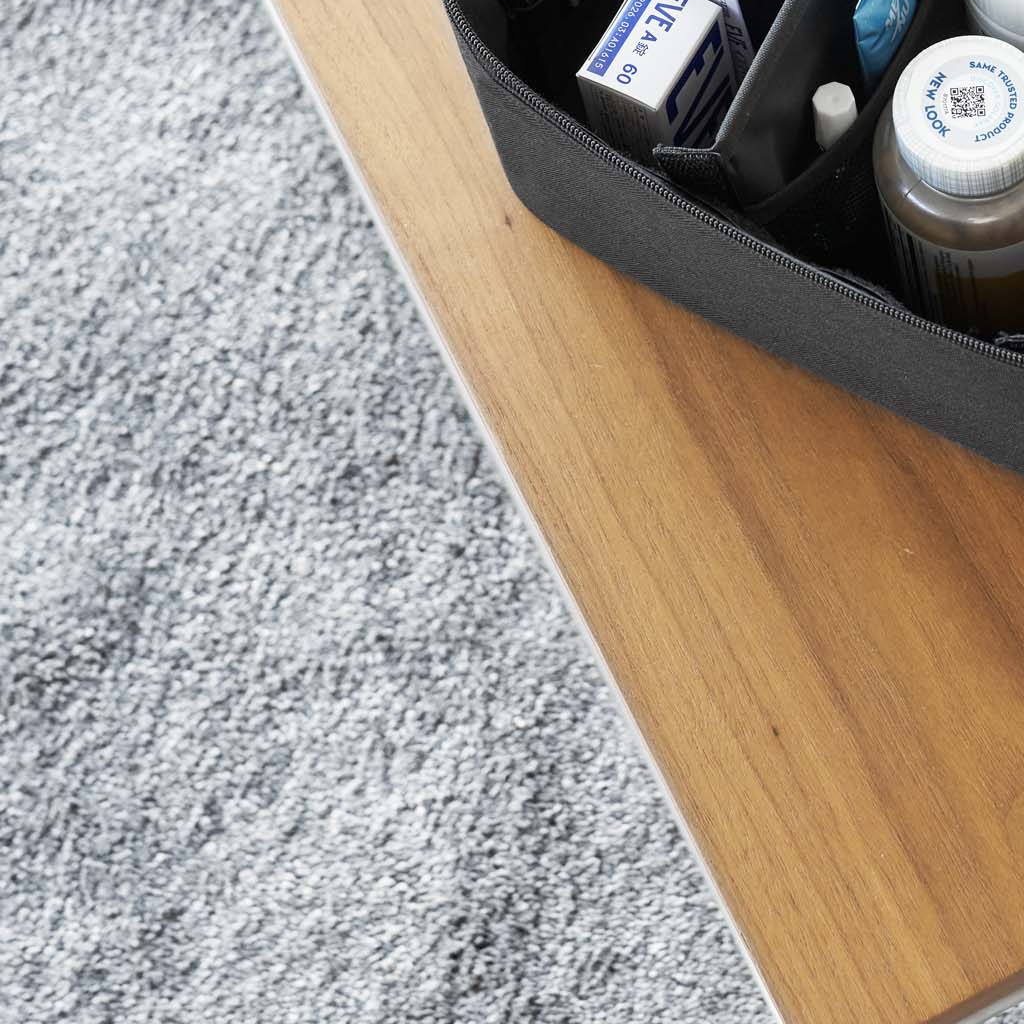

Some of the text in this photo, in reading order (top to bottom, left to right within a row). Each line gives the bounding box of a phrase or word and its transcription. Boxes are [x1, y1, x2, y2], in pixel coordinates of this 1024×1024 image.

[616, 63, 638, 85] 60
[969, 61, 998, 75] SAME
[998, 70, 1018, 109] TRUSTED
[924, 72, 951, 137] NEW LOOK
[974, 113, 1014, 142] PRODUCT
